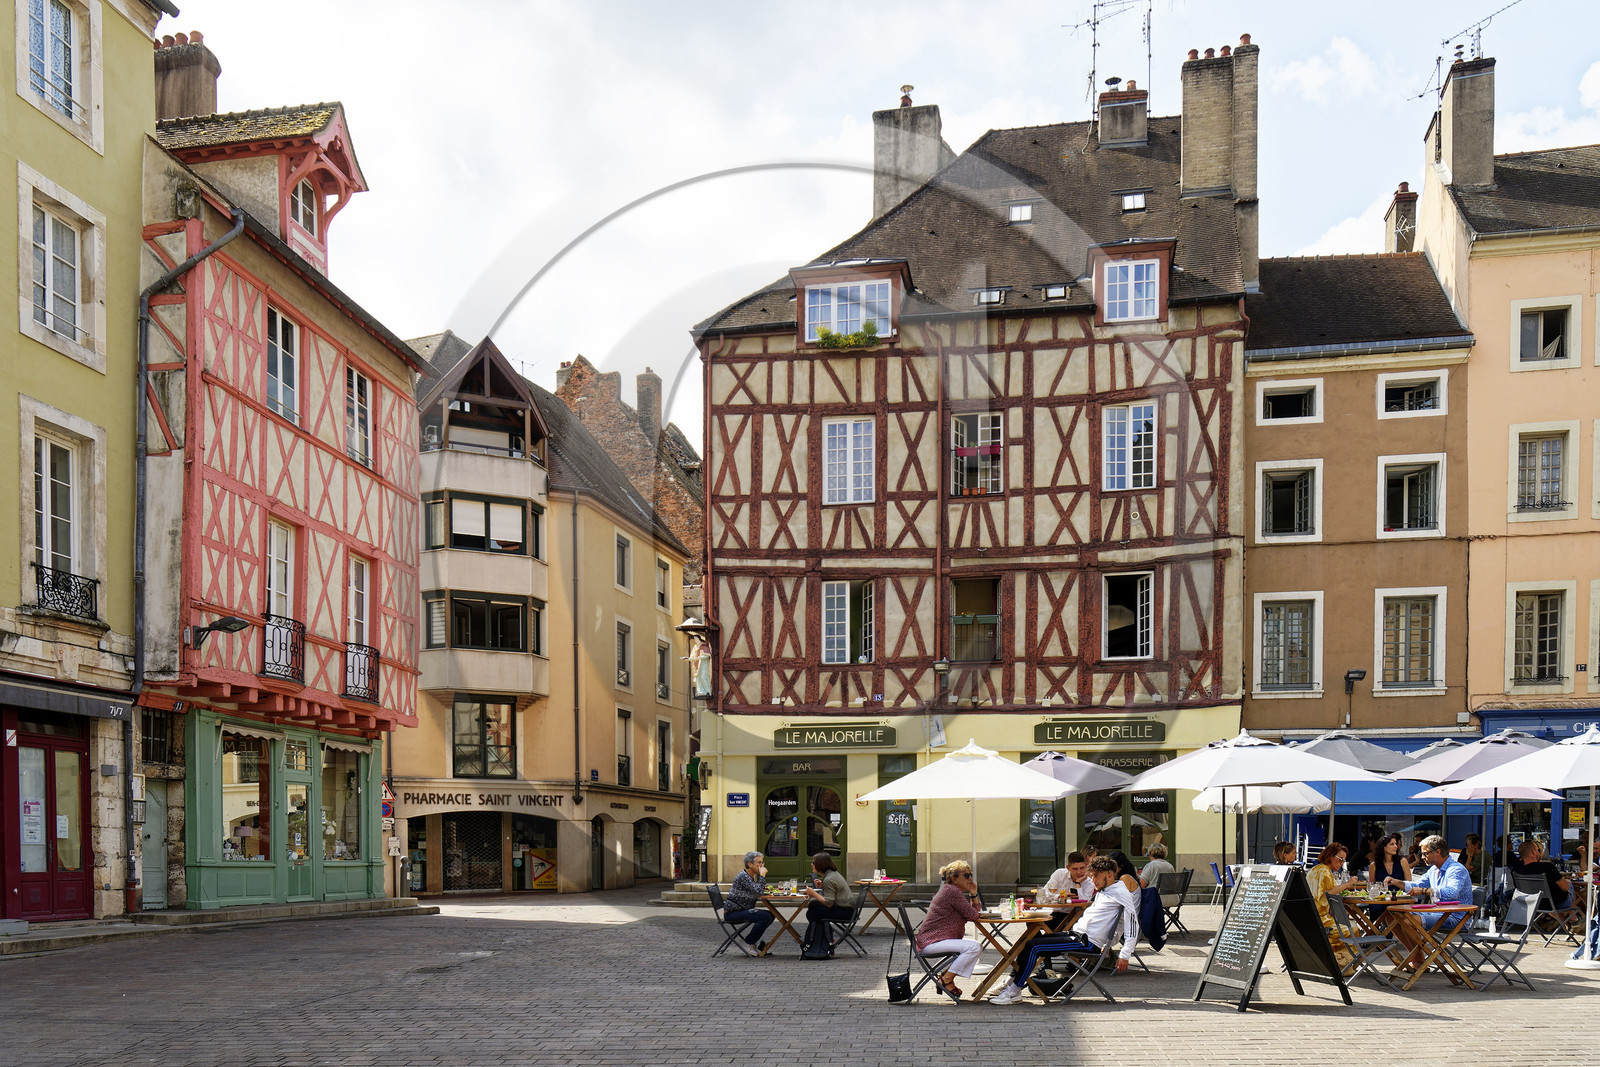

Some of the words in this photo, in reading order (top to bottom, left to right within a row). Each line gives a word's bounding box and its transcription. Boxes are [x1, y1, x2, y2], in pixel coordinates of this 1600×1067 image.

[785, 731, 801, 744] LE
[804, 730, 884, 744] MAJORELLE
[1046, 727, 1062, 740] LE
[1067, 725, 1153, 739] MAJORELLE
[792, 763, 812, 771] BAR
[1100, 758, 1153, 767] BRASSERIE
[403, 792, 472, 805] PHARMACIE
[478, 794, 512, 806] SAINT
[517, 794, 564, 807] VINCENT
[767, 799, 797, 807] Hoegaarden
[1133, 796, 1165, 804] Hoegaarden
[887, 813, 910, 825] Leffe
[1031, 812, 1054, 825] Leffe
